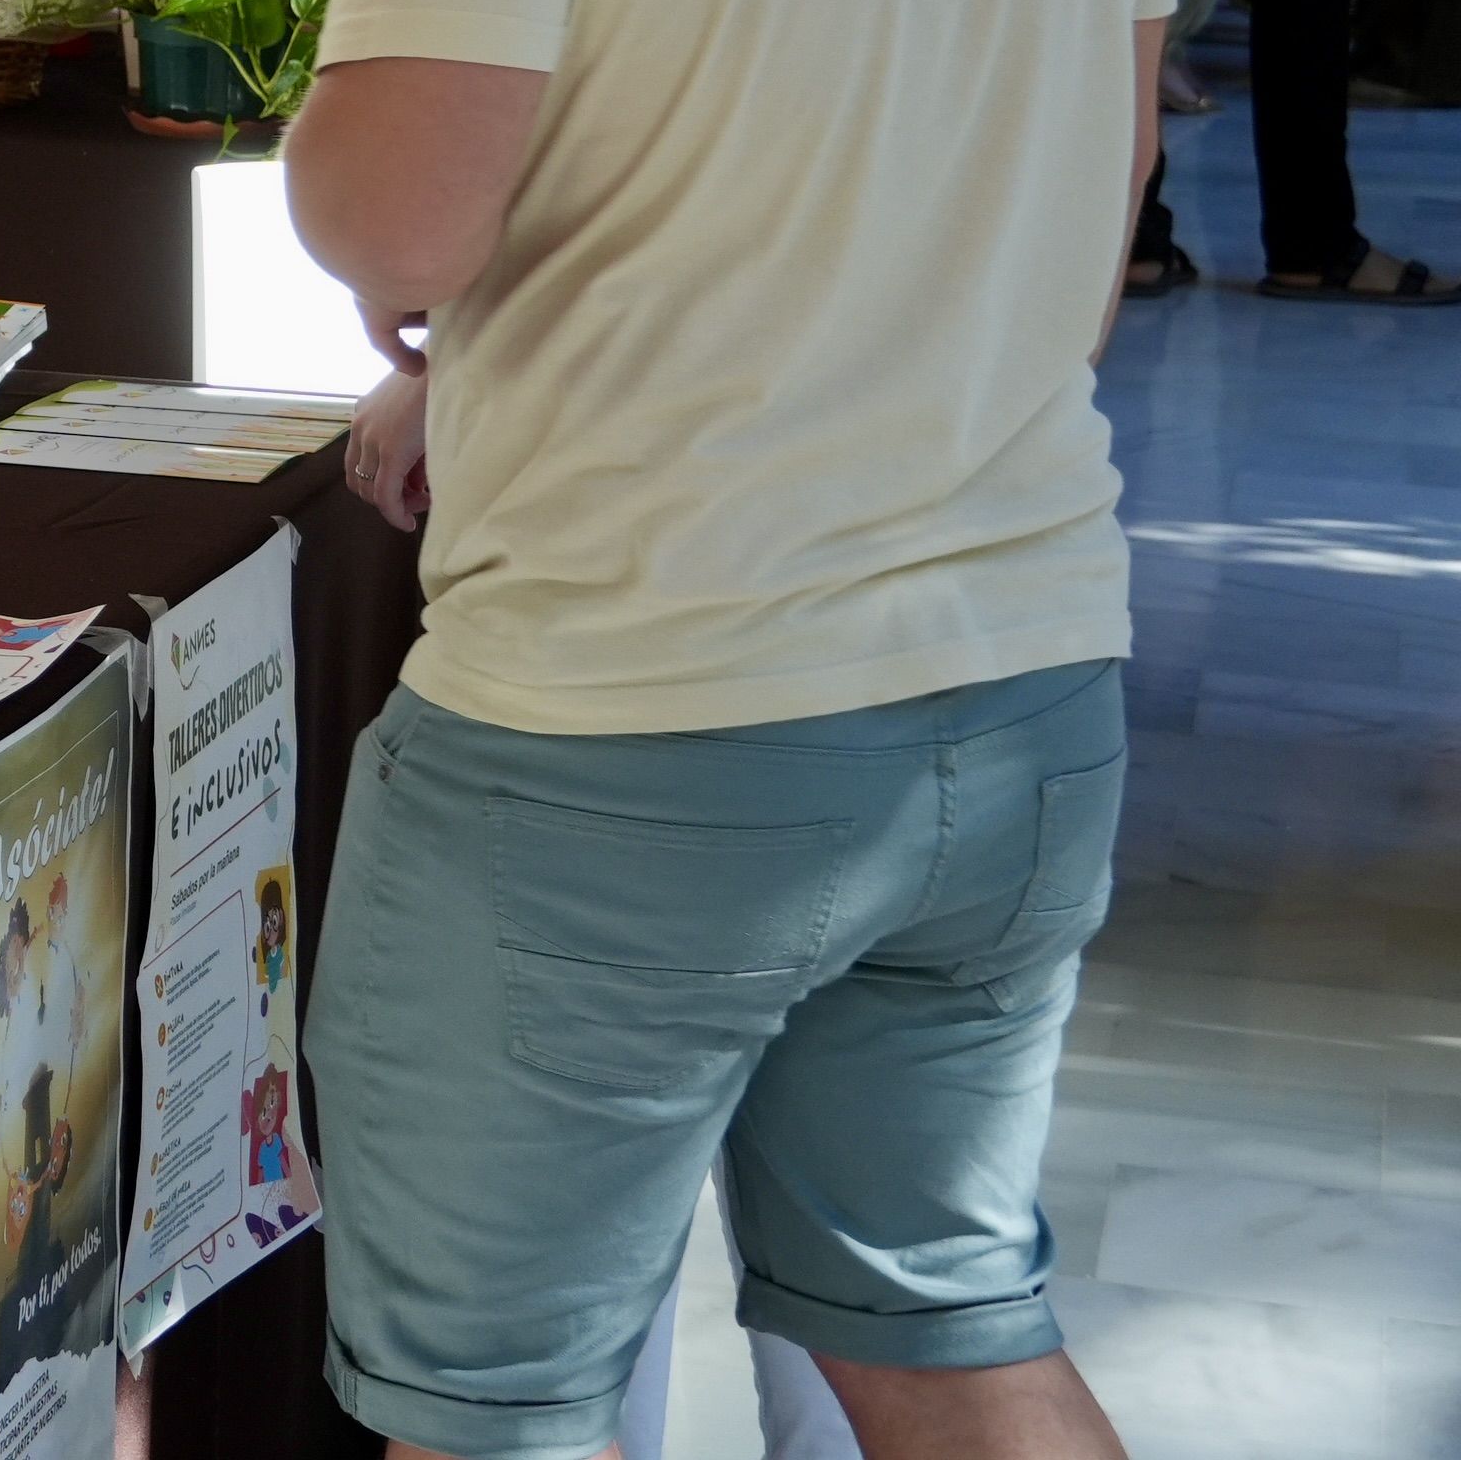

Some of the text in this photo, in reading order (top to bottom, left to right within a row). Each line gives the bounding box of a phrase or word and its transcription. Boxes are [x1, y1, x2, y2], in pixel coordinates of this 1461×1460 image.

[169, 646, 283, 776] TALLERES DIVERTIDOS
[171, 795, 181, 841] E
[171, 880, 198, 910] Sábados
[198, 869, 210, 892] por
[17, 1224, 102, 1331] Por ti, por todos.
[23, 1368, 50, 1406] NUESTRA
[28, 1379, 58, 1423] NUESTRAS
[38, 1390, 67, 1431] NUESTROS
